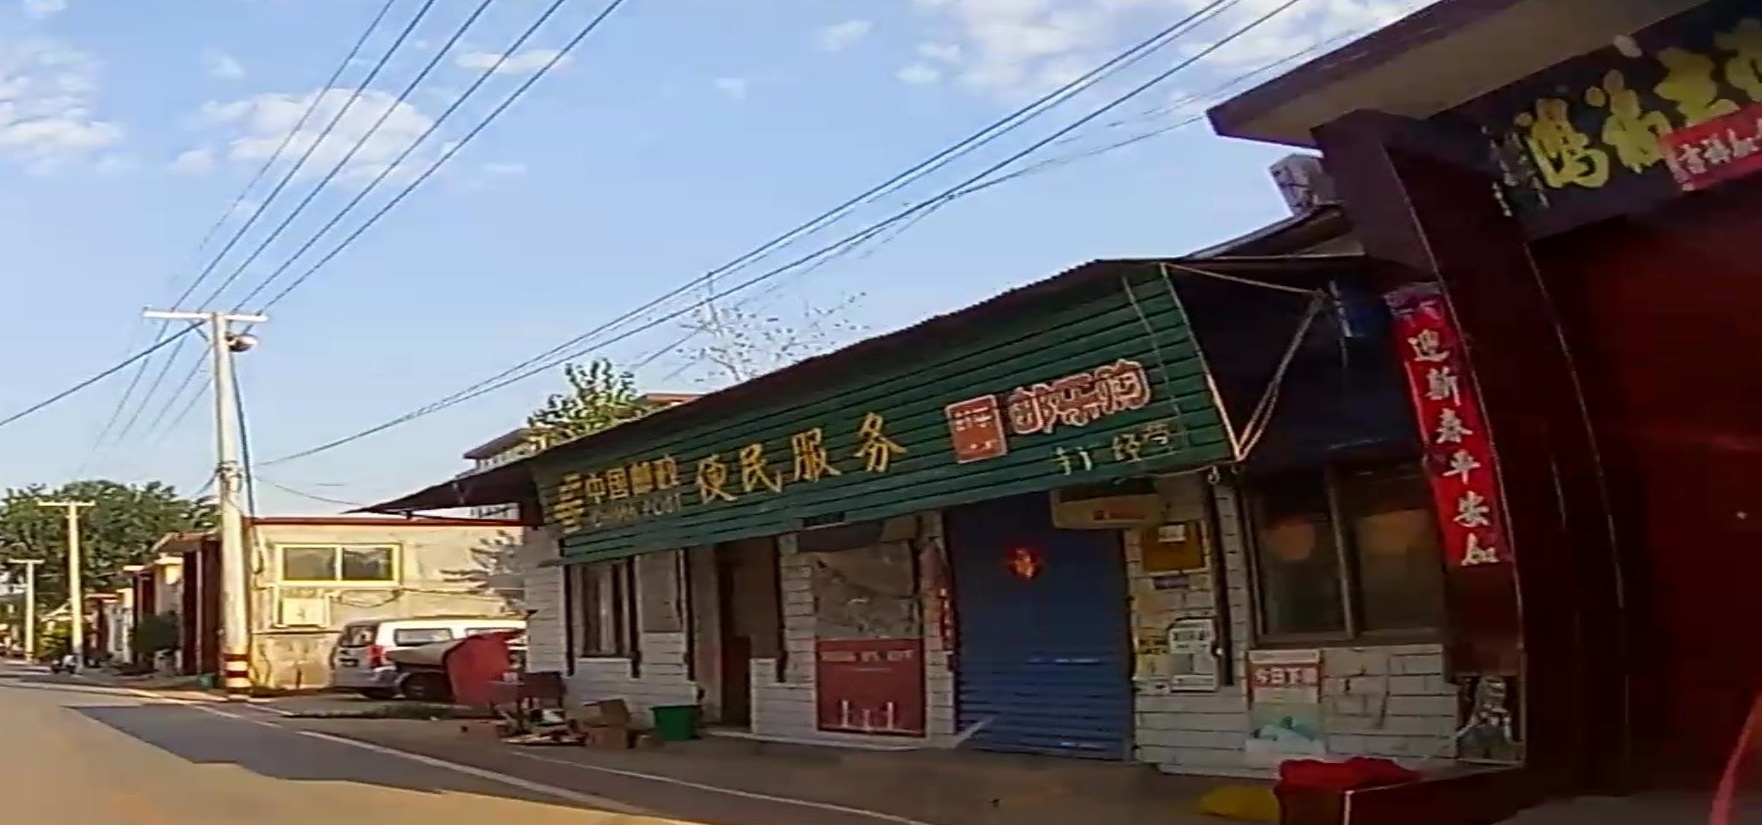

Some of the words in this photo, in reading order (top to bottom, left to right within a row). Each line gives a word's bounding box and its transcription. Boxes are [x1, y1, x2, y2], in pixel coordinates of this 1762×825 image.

[585, 454, 680, 503] 中国邮政
[696, 412, 907, 504] 便民服务
